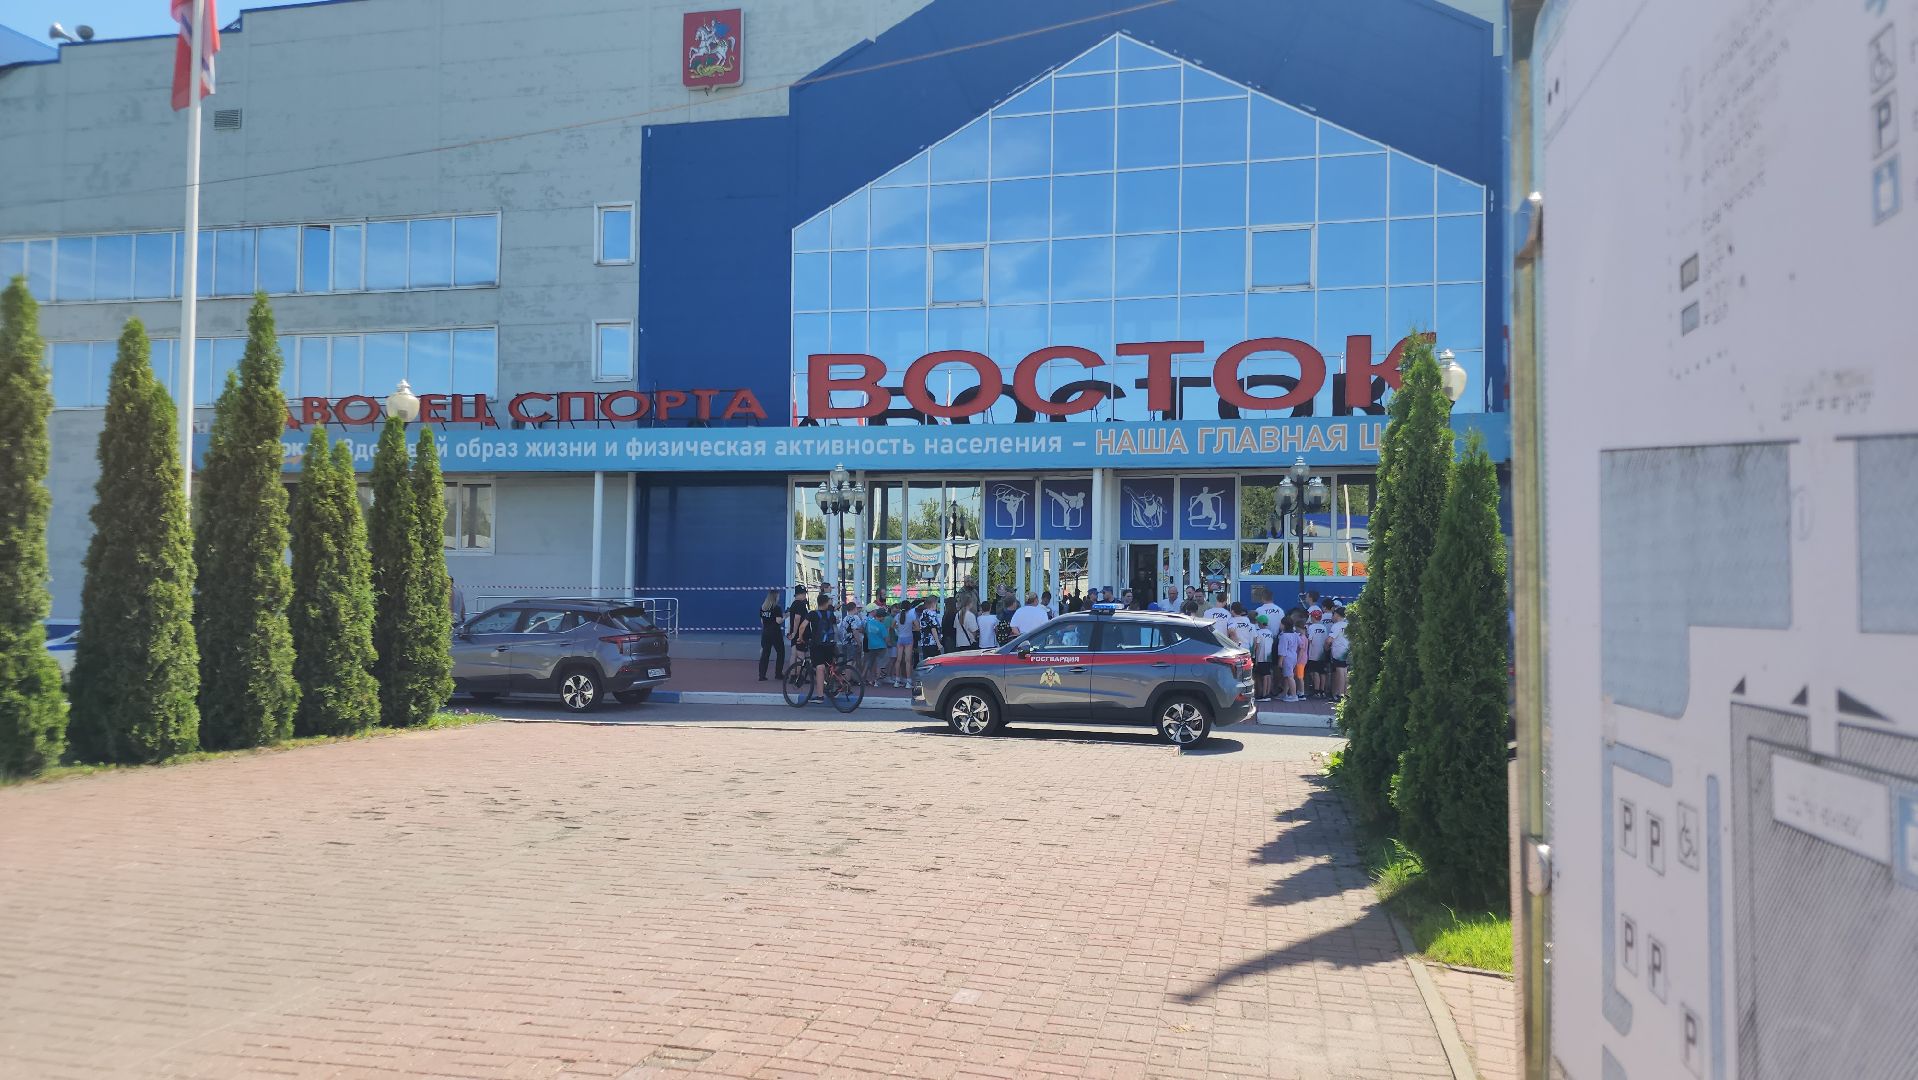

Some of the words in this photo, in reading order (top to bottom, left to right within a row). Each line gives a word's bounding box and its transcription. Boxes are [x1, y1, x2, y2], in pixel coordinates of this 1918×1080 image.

[808, 331, 1437, 419] ВОСТОК
[286, 394, 495, 429] ВОЕЦ
[508, 389, 768, 422] СПОРТА
[455, 437, 518, 463] образ
[525, 441, 596, 458] жизни
[605, 441, 618, 457] и
[625, 437, 766, 461] физическая
[774, 437, 915, 457] активность
[924, 435, 1062, 455] населения
[1095, 428, 1188, 456] НАША
[1198, 423, 1347, 454] ГЛАВНАЯ
[1030, 656, 1080, 664] РОСГВАРДИЯ
